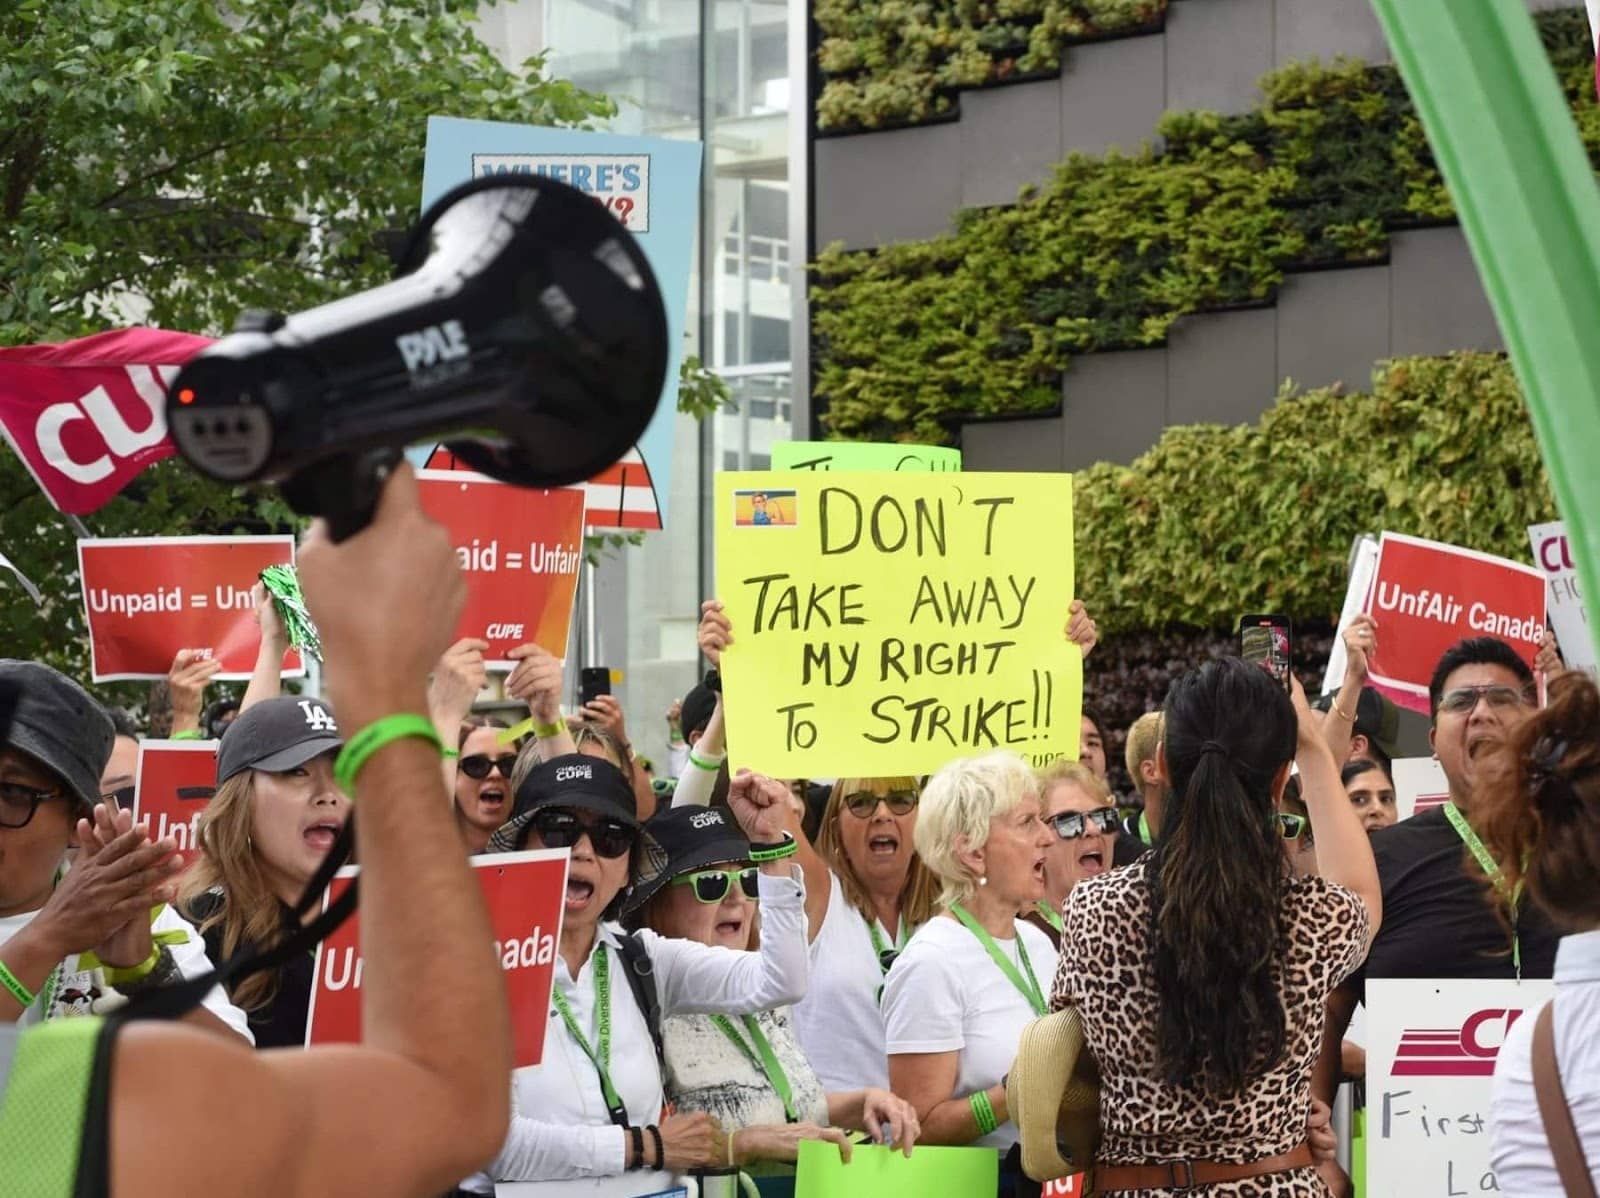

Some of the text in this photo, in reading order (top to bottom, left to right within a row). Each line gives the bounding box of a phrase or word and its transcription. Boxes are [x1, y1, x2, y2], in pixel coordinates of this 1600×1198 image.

[35, 364, 181, 484] CU
[820, 486, 1014, 557] DON'T
[530, 542, 578, 574] Unfair
[89, 587, 182, 618] Unpaid
[743, 573, 1036, 634] TAKE AWAY
[1377, 581, 1463, 625] UnfAir
[1468, 602, 1544, 644] Canada
[486, 623, 524, 640] CUPE
[802, 637, 1016, 688] MY RIGHT
[298, 700, 337, 731] LA
[863, 669, 1052, 748] STRIKE!!
[556, 770, 592, 781] CUPE
[1461, 1008, 1524, 1058] C
[1382, 1090, 1485, 1139] First
